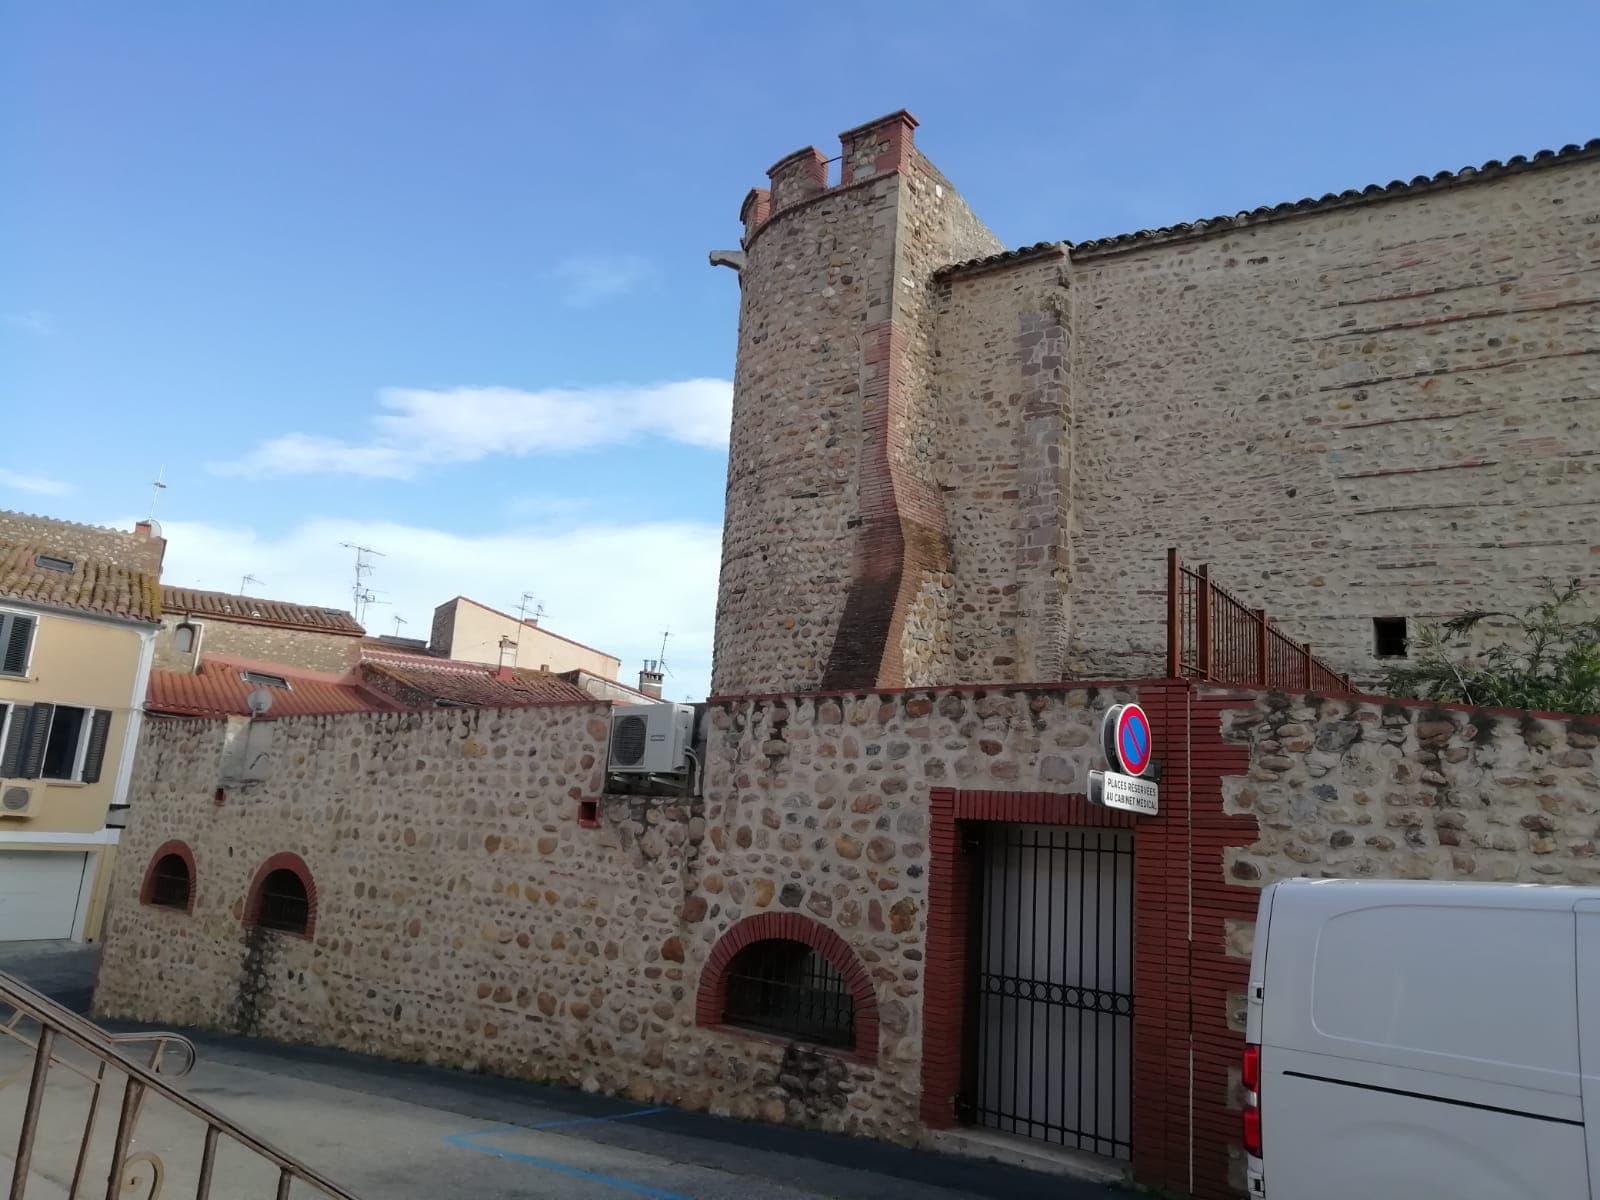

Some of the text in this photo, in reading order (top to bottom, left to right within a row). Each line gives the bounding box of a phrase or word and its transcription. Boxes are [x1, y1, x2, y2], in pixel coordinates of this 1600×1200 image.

[1107, 777, 1127, 791] PLACES
[1106, 791, 1113, 801] AU
[1114, 793, 1135, 806] CABINET
